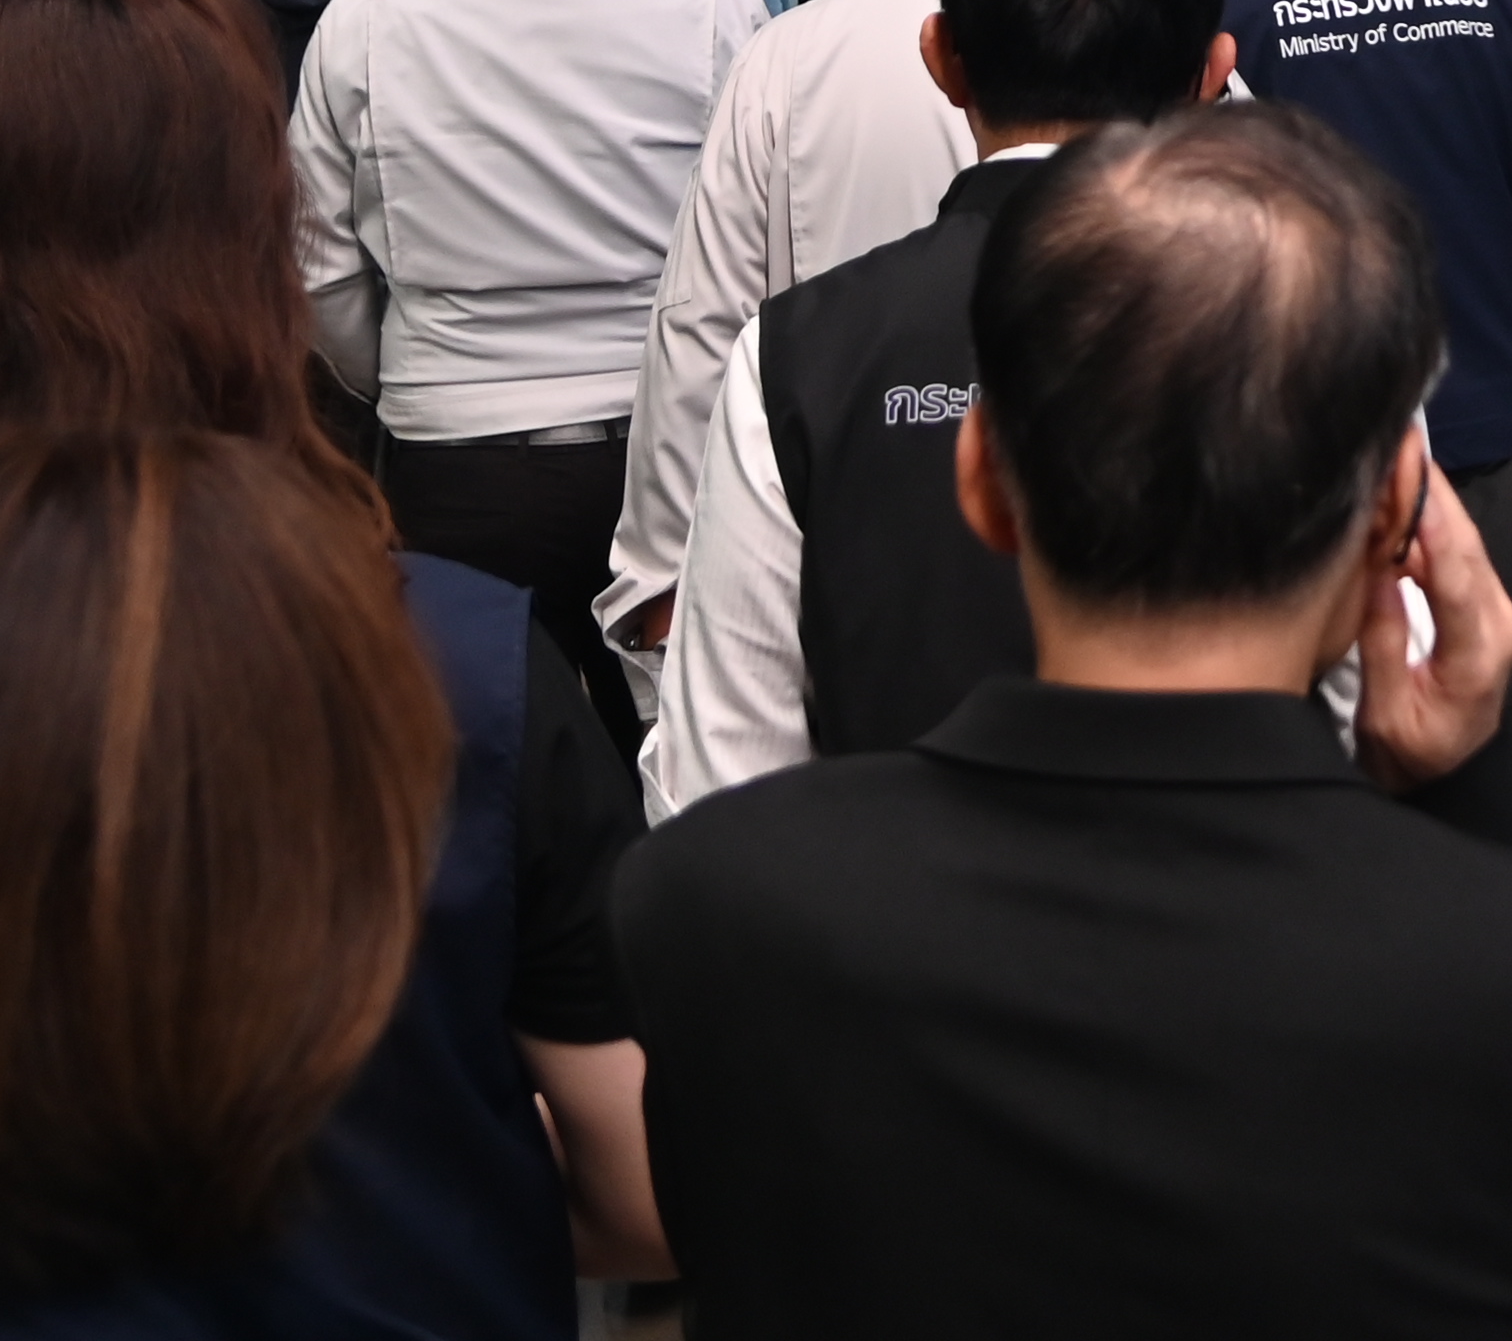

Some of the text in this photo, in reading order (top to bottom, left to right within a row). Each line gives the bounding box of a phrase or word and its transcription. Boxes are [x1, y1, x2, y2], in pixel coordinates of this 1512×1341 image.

[1279, 19, 1494, 58] Ministry of Commerce
